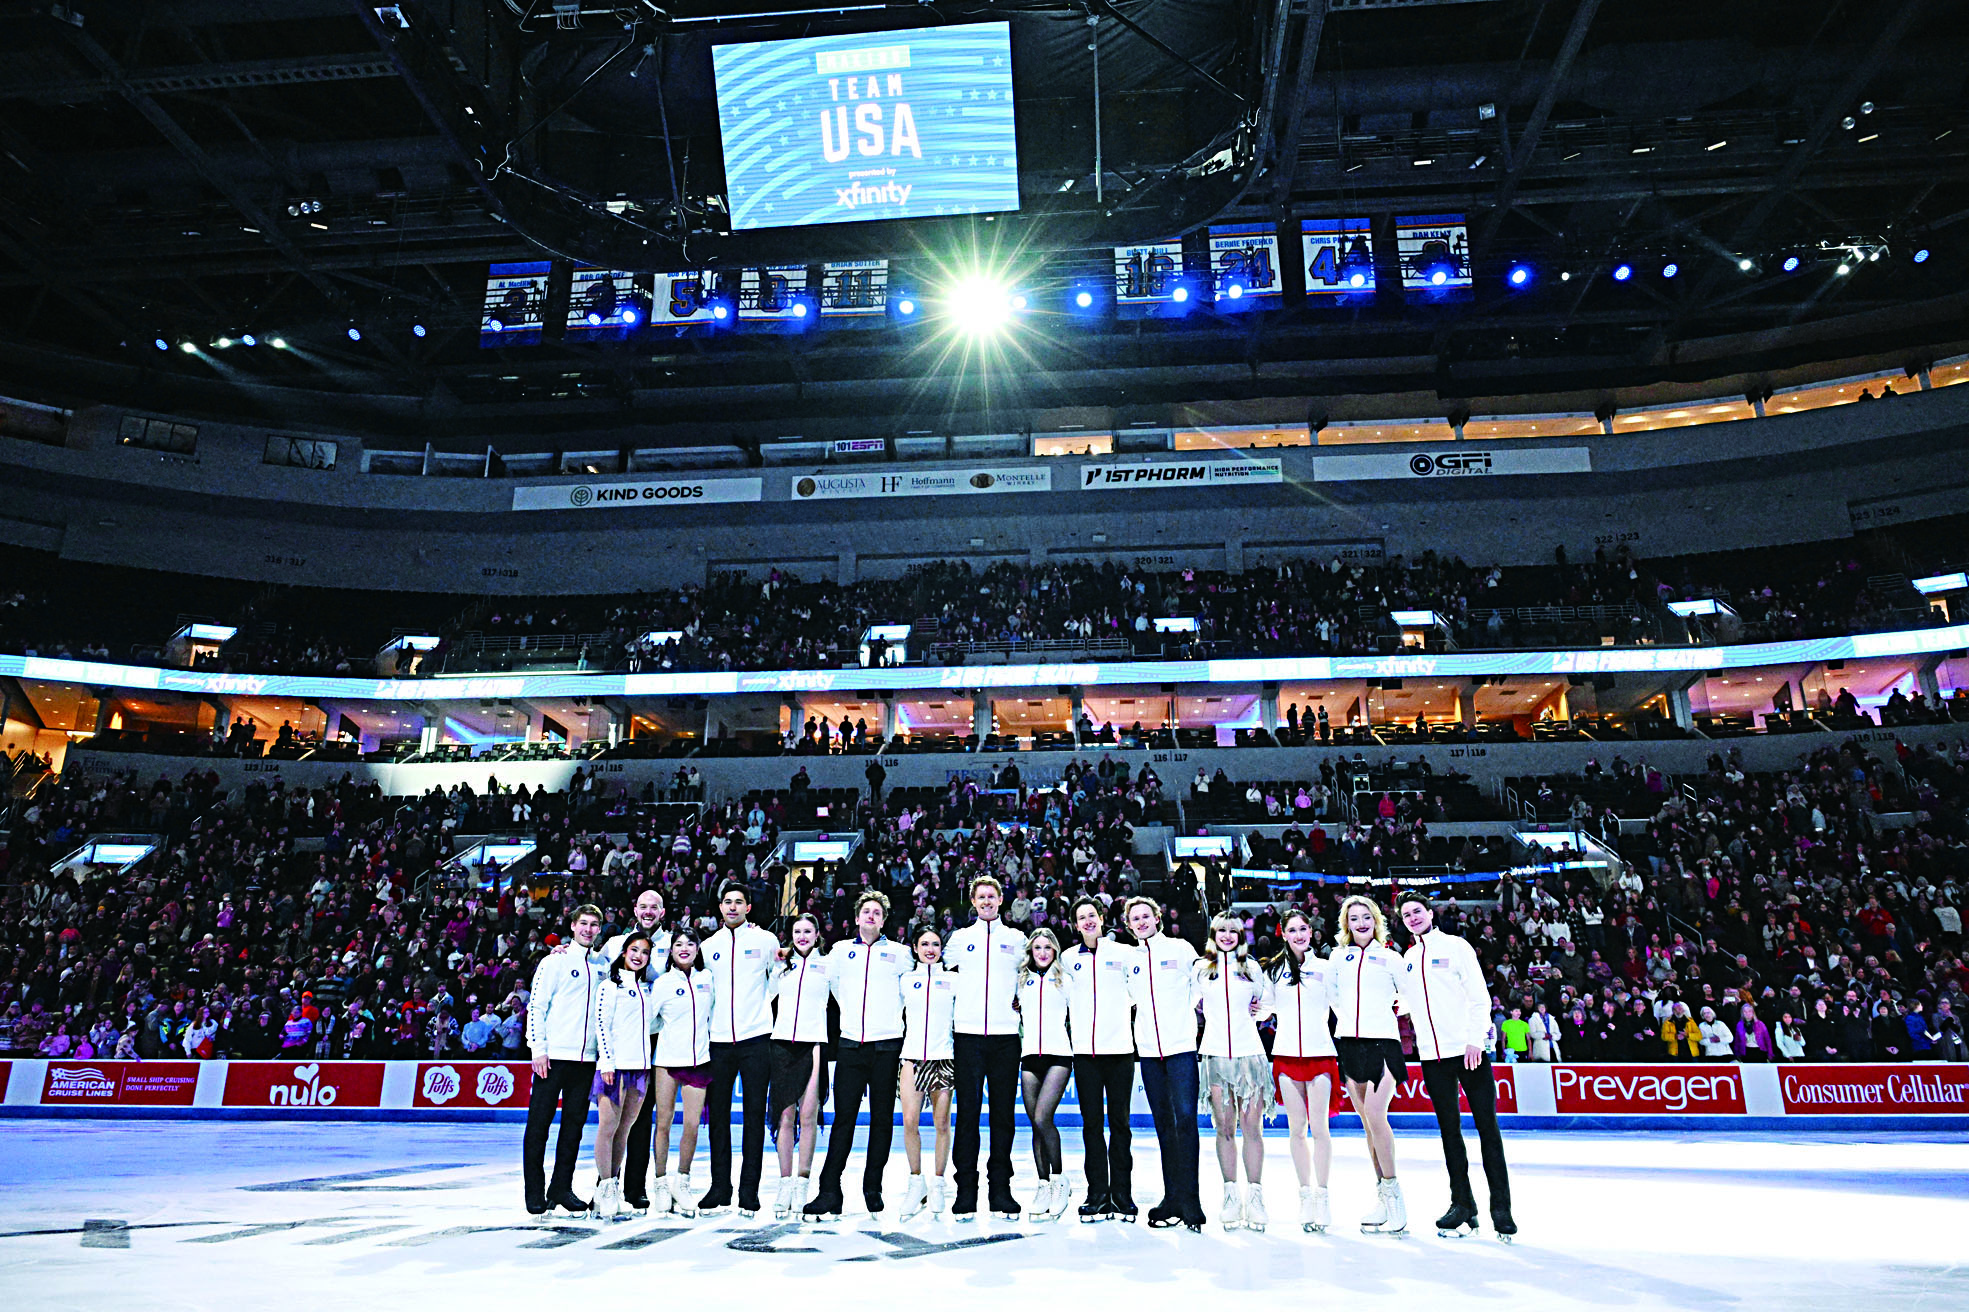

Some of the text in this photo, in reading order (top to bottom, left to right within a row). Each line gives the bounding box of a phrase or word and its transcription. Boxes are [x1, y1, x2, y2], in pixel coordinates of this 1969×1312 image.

[829, 74, 902, 101] TEAM
[821, 104, 922, 162] USA
[886, 167, 897, 177] by
[836, 180, 912, 209] xfinity
[1215, 239, 1240, 248] BERNIE
[1310, 236, 1331, 244] CHRIS
[836, 440, 883, 451] 101 ESPN
[996, 474, 1046, 482] MONTELLE
[1135, 467, 1206, 482] PHORM
[1436, 467, 1493, 476] DIGITAL
[816, 478, 867, 490] AUGUSTA
[911, 477, 955, 486] Hoffmann
[597, 486, 703, 501] KIND GOODS
[1375, 656, 1436, 675] xfinity
[205, 673, 267, 695] xfinity
[778, 671, 836, 690] xfinity
[885, 759, 899, 767] 116
[51, 1081, 115, 1090] AMERICAN
[270, 1075, 337, 1106] nulo
[429, 1072, 455, 1096] Puffs
[482, 1072, 508, 1096] Puffs
[1554, 1069, 1737, 1110] Prevagen
[1784, 1074, 1965, 1104] Consumer Cellular
[49, 1089, 85, 1097] CRUISE
